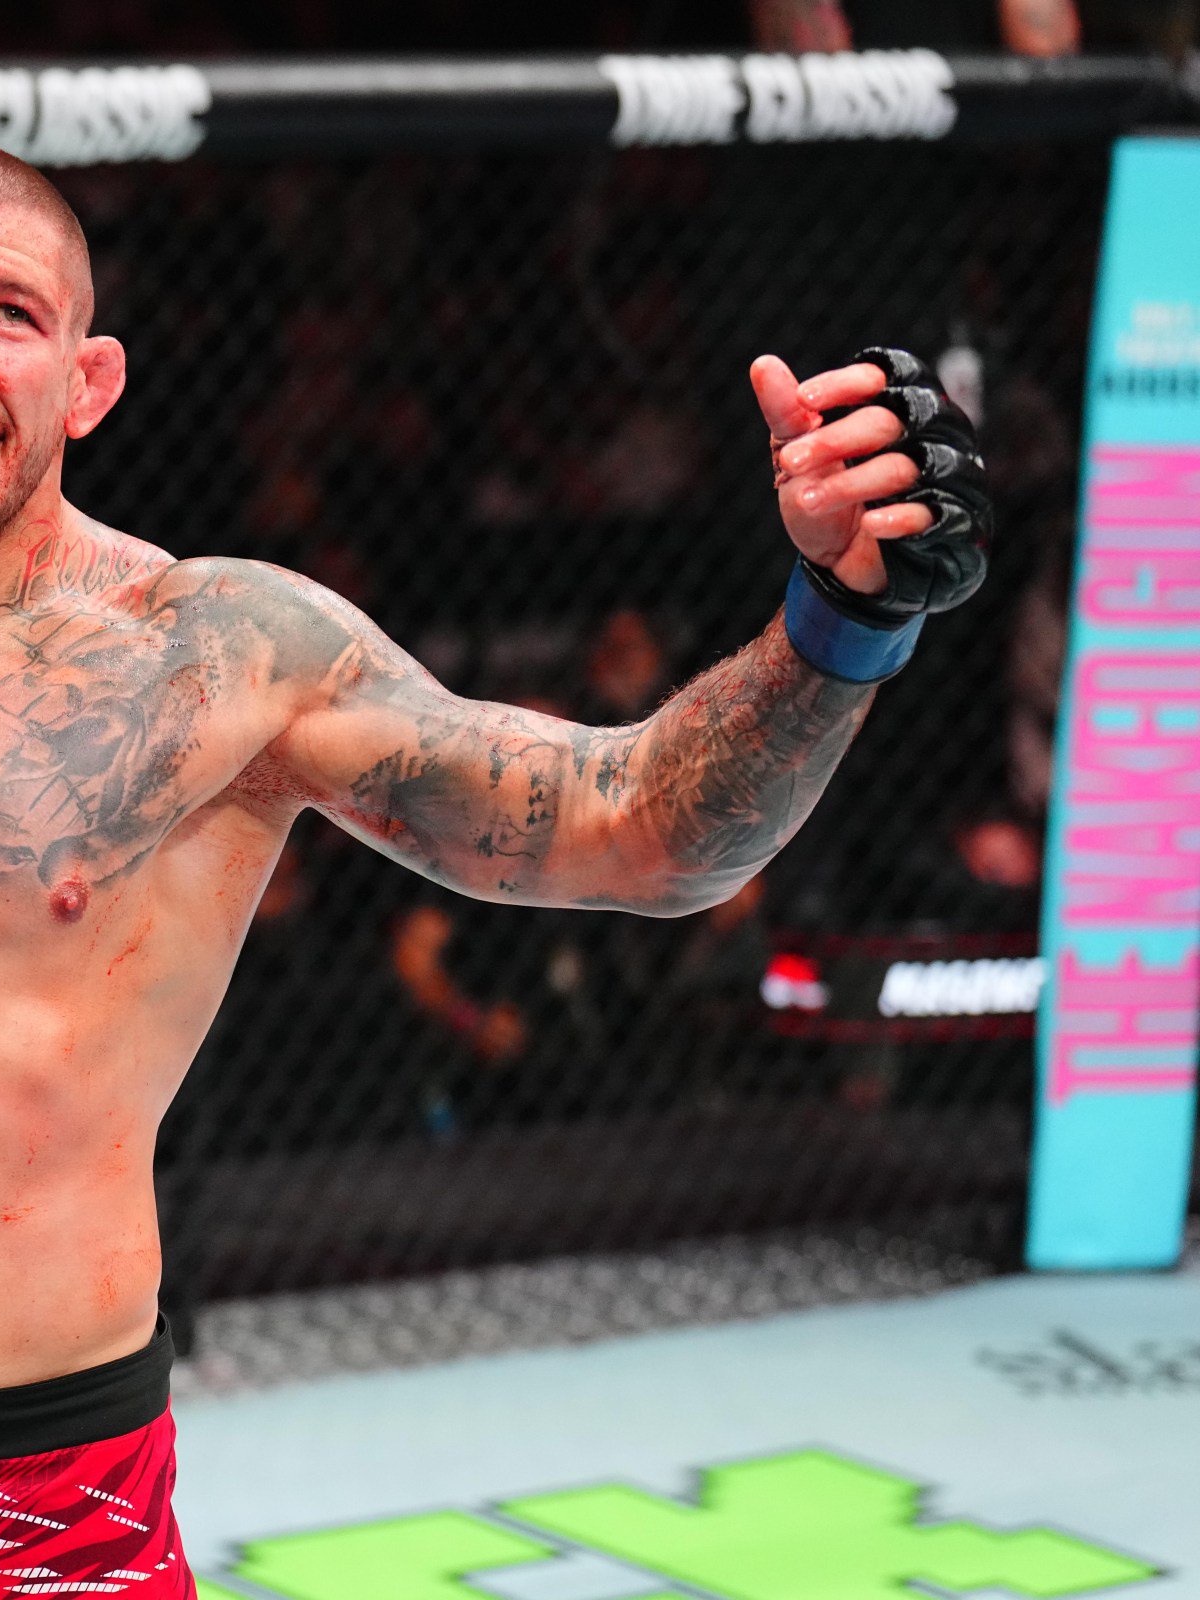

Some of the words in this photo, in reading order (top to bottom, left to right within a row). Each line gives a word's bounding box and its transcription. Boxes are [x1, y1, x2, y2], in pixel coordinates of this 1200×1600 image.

[1082, 444, 1200, 628] GUN
[1063, 650, 1200, 927] NAKED
[1051, 946, 1198, 1105] THE
